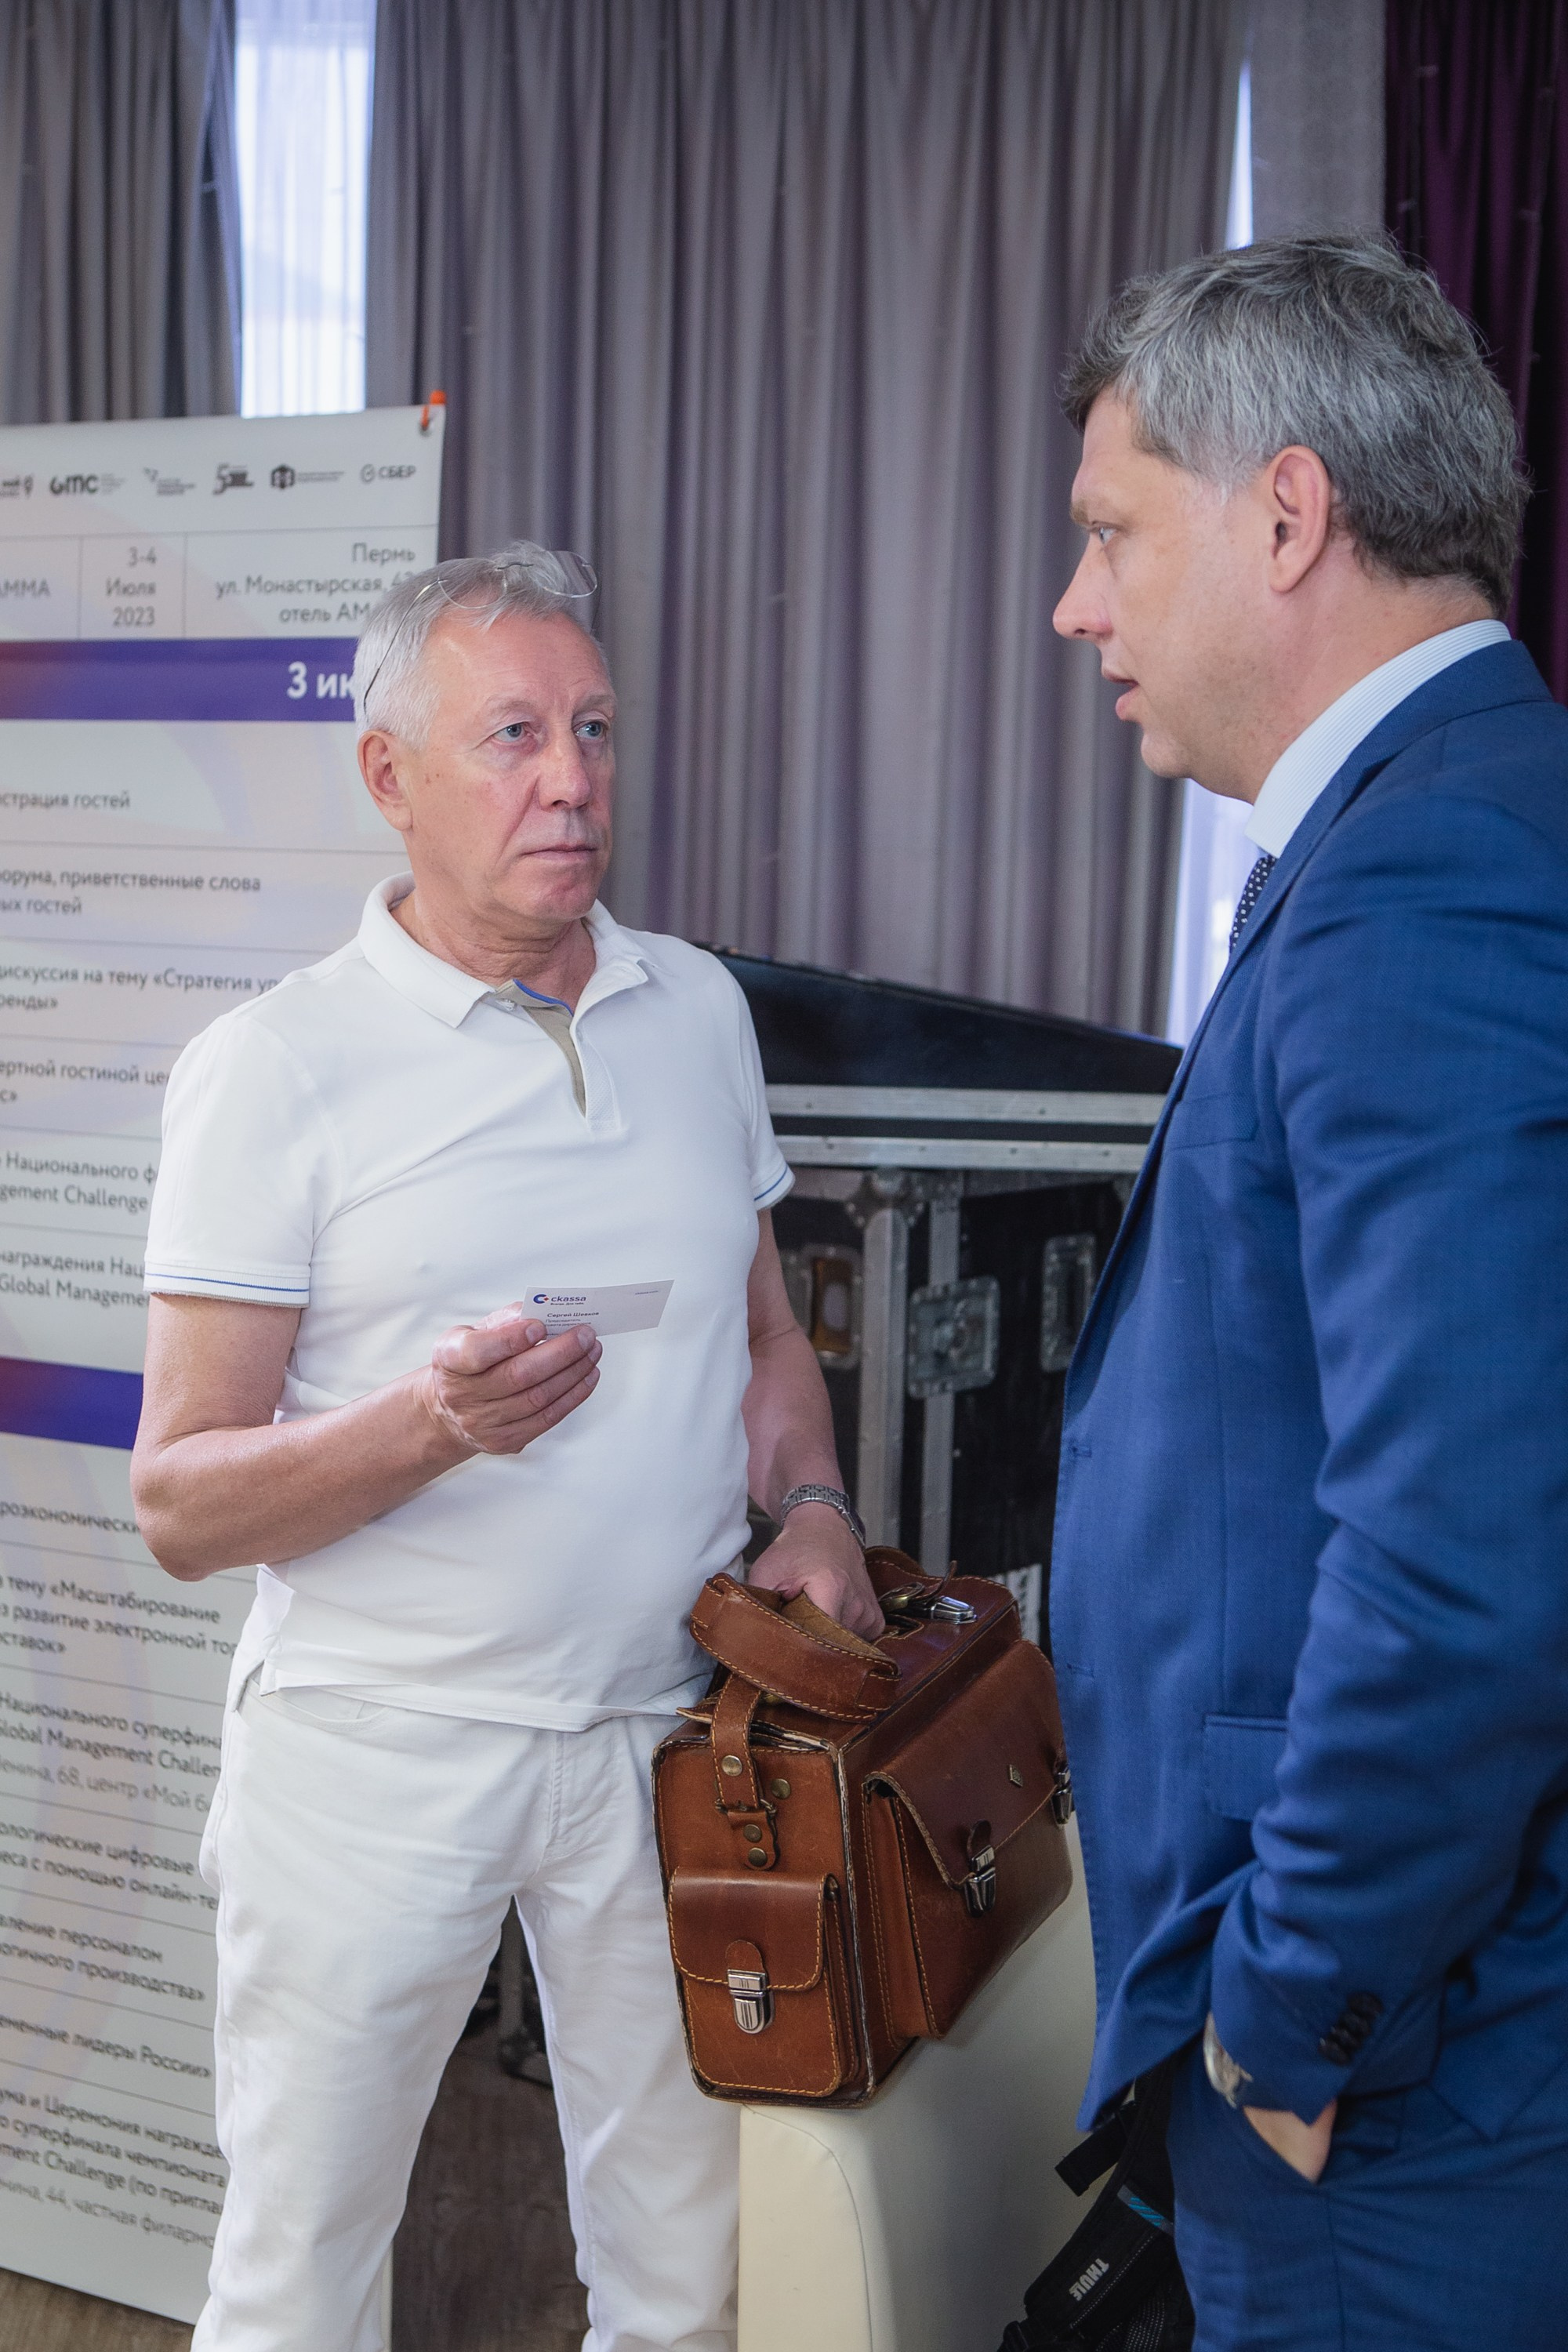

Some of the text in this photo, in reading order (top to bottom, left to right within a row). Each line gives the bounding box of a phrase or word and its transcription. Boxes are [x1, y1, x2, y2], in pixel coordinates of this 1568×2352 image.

[126, 546, 157, 567] 3-4
[351, 541, 416, 566] Пермь
[106, 576, 156, 597] Июля
[113, 605, 155, 627] 2023
[278, 608, 332, 624] отель
[286, 660, 308, 699] 3
[0, 790, 130, 810] страция гостей
[0, 869, 261, 891] орума, приветственные слова
[26, 896, 82, 915] гостей
[83, 971, 103, 984] на
[108, 971, 149, 992] тему
[153, 967, 252, 993] «Стратегия
[60, 1064, 140, 1083] гостиной
[6, 1151, 139, 1181] Национального
[64, 1183, 149, 1214] Challenge
[7, 1574, 221, 1624] тему «Масштабирование
[13, 1603, 90, 1632] развитие
[93, 1618, 207, 1651] электронной
[47, 1726, 154, 1766] Management
[86, 1775, 140, 1801] центр
[43, 1858, 126, 1889] помощью
[42, 2149, 127, 2191] Challenge
[1068, 2258, 1109, 2301] THULE
